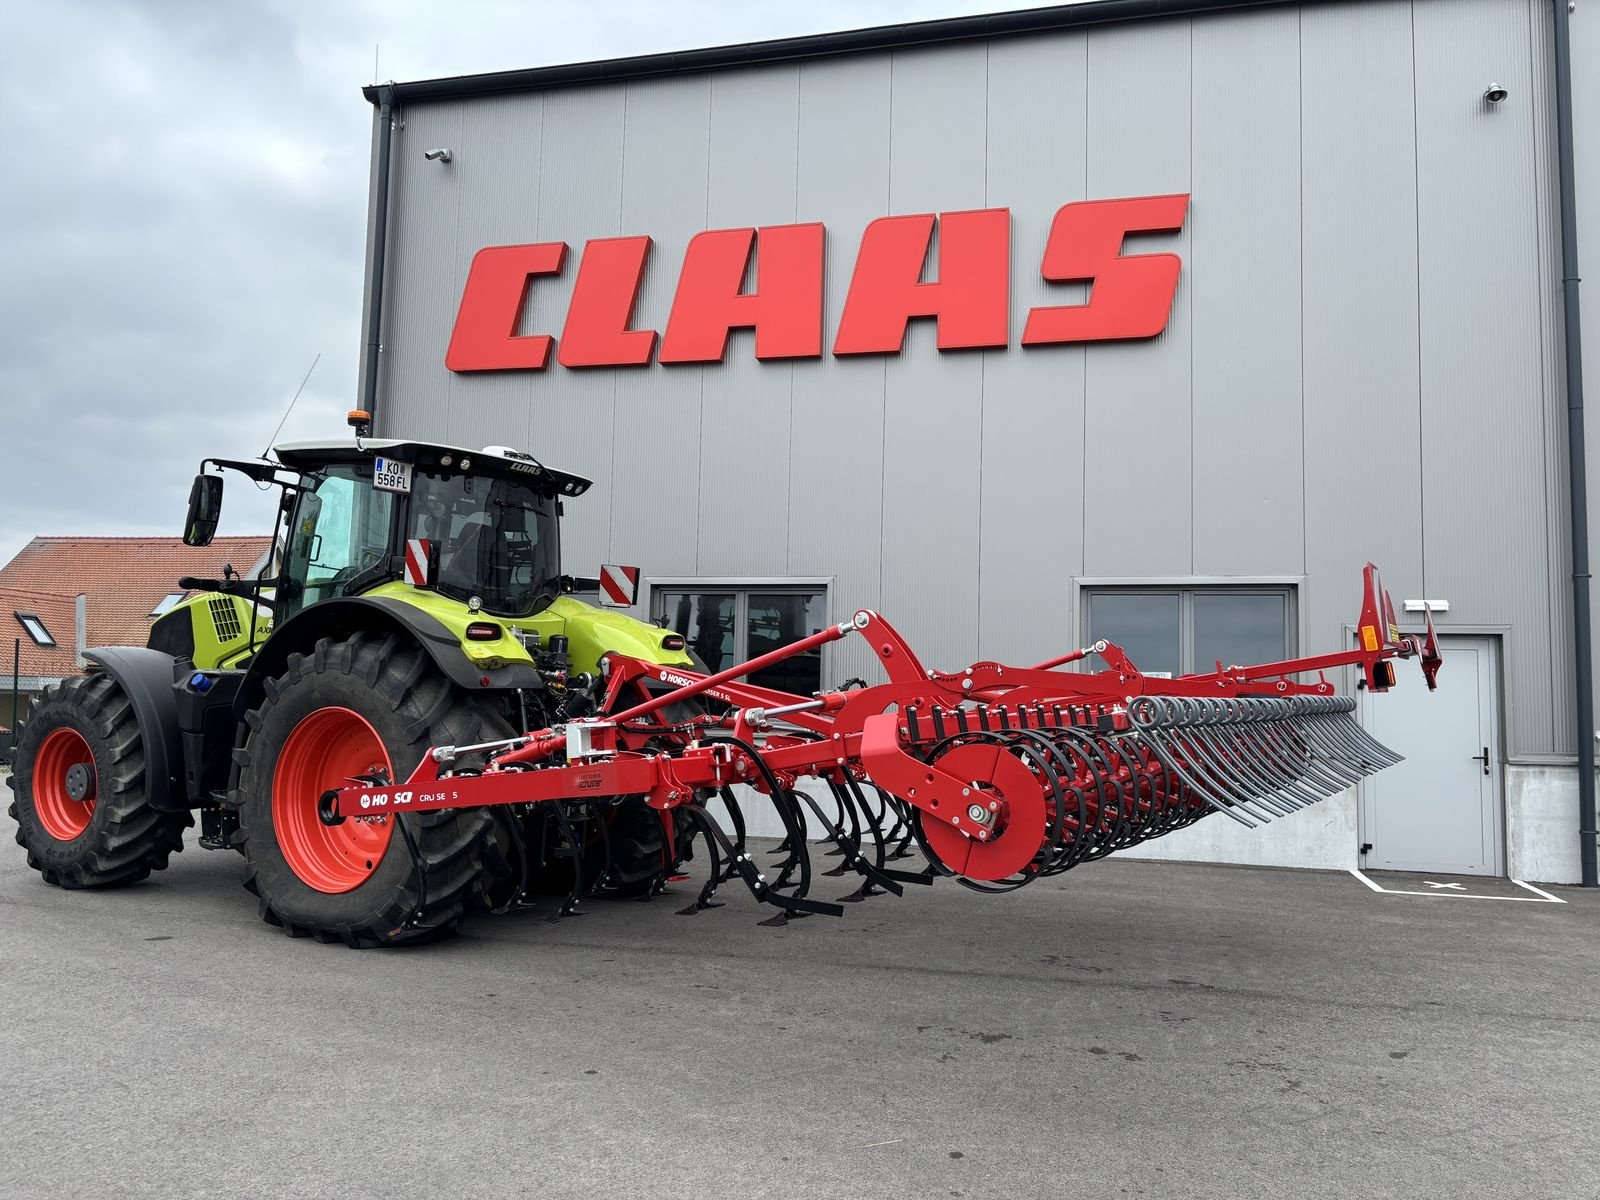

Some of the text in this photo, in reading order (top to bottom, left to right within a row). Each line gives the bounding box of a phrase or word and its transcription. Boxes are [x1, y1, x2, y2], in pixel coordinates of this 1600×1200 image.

[445, 193, 1191, 373] CLAAS
[386, 461, 399, 475] KO
[510, 462, 542, 475] CLAAS
[377, 473, 407, 489] 558 FL
[257, 626, 273, 634] AXI
[452, 791, 458, 799] 5
